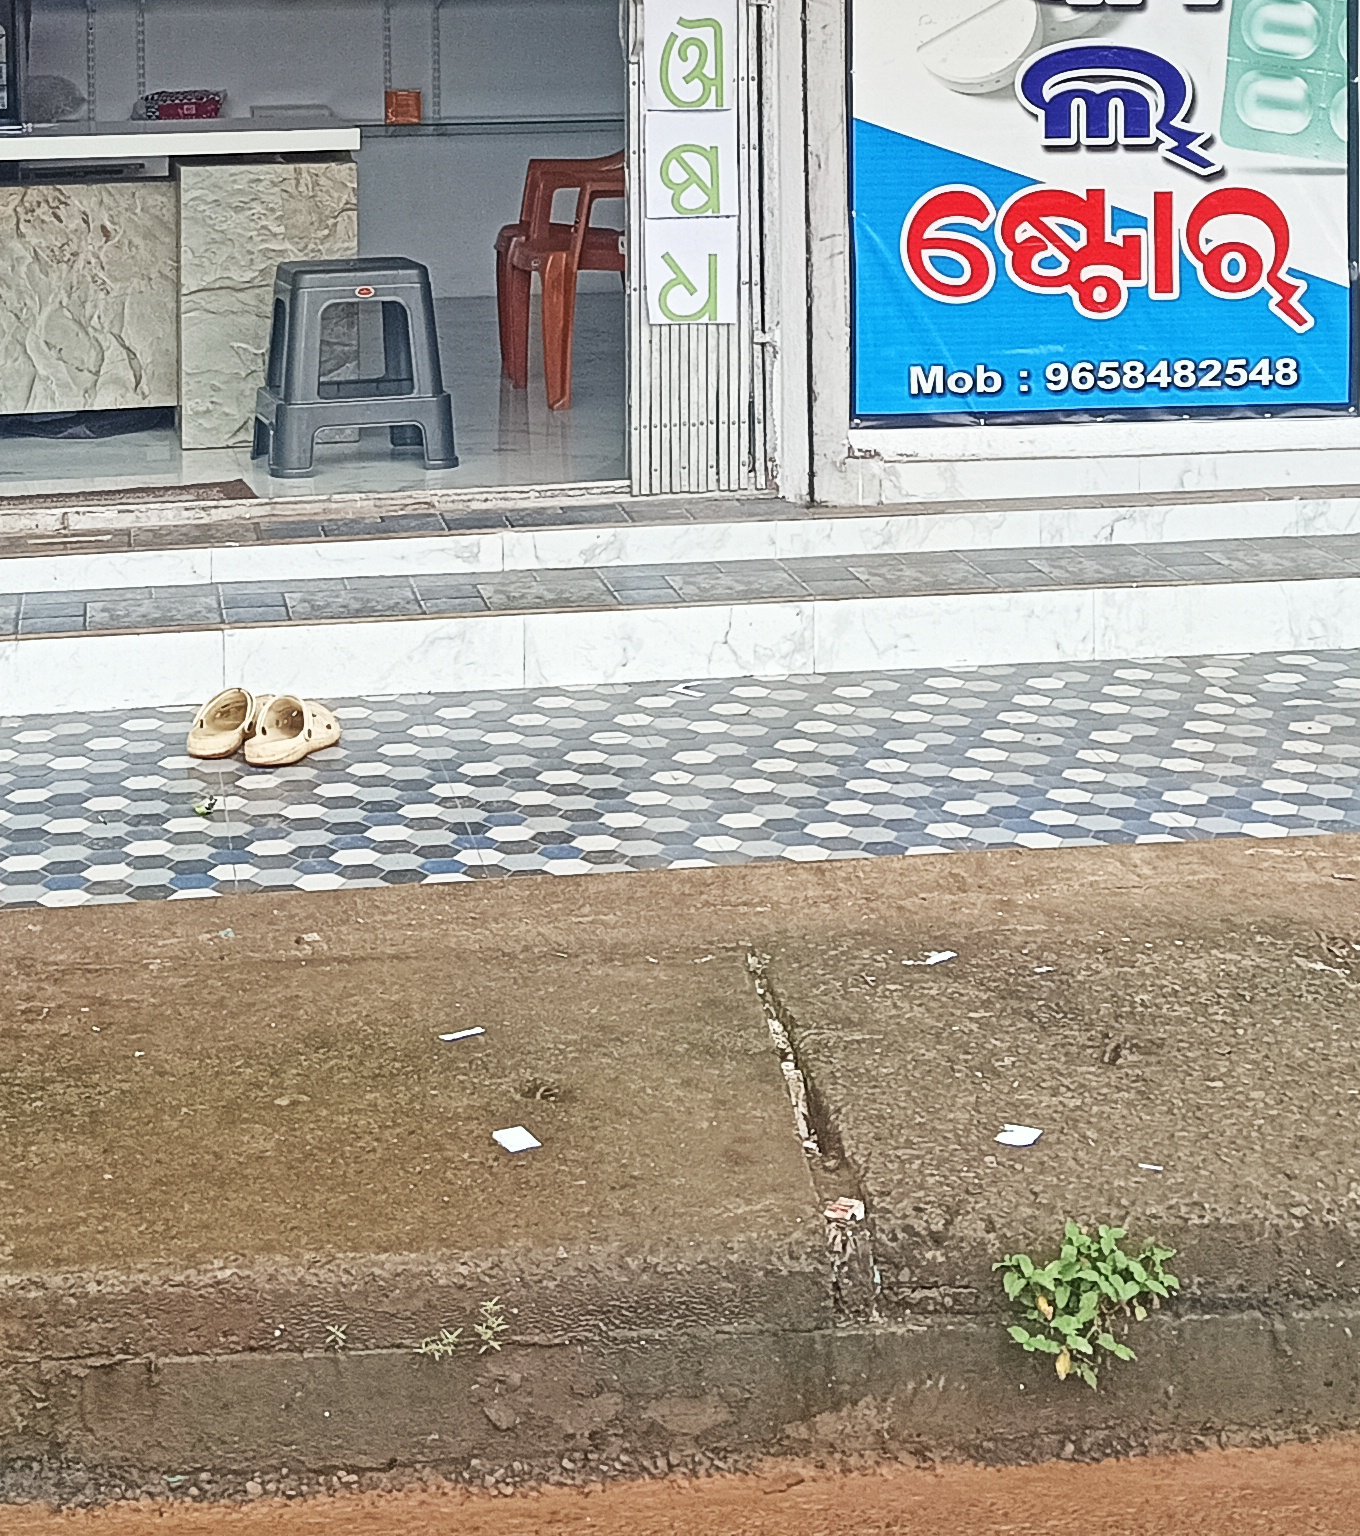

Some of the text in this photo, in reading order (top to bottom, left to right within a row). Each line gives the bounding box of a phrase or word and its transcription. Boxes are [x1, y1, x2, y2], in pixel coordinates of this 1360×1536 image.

[901, 184, 1315, 333] ଷ୍ଟୋର୍
[908, 364, 1002, 395] Mob
[1044, 357, 1299, 392] 9658482548
